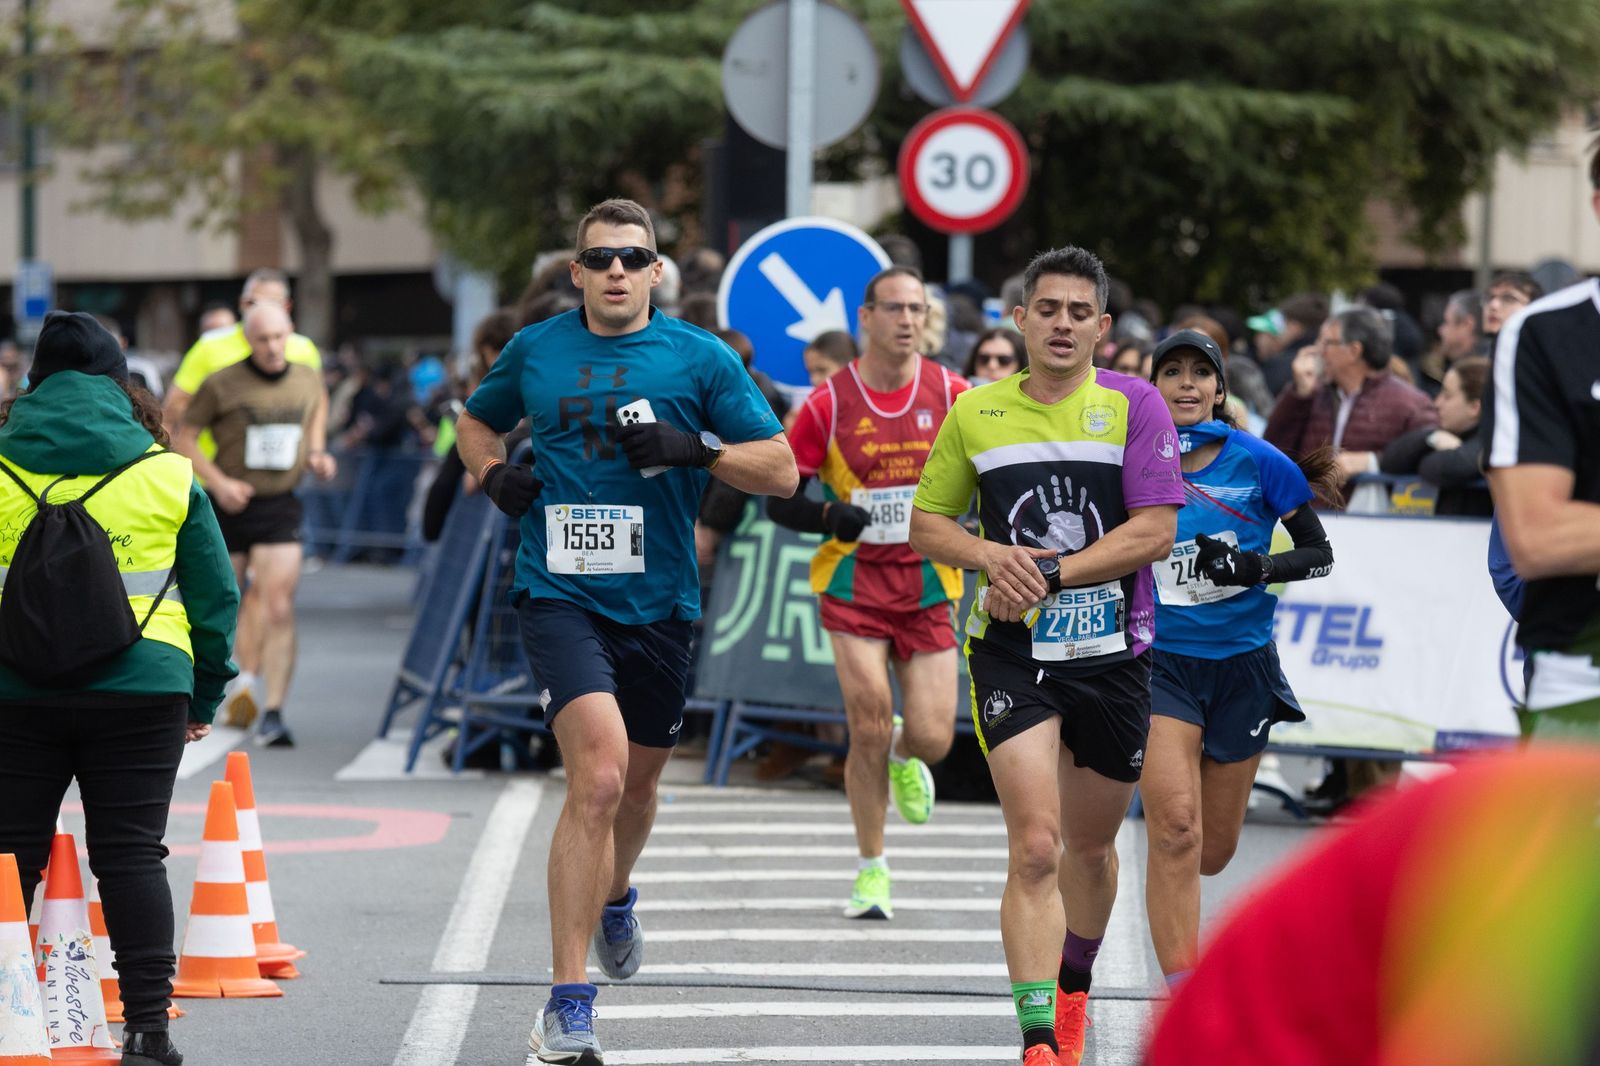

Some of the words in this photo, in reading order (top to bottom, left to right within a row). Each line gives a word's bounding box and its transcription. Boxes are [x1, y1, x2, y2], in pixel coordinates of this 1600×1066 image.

[930, 151, 996, 192] 30
[571, 508, 633, 520] SETEL
[563, 523, 615, 550] 1553
[1059, 588, 1117, 605] SETEL
[1045, 603, 1105, 638] 2783
[1311, 647, 1380, 671] Grupo
